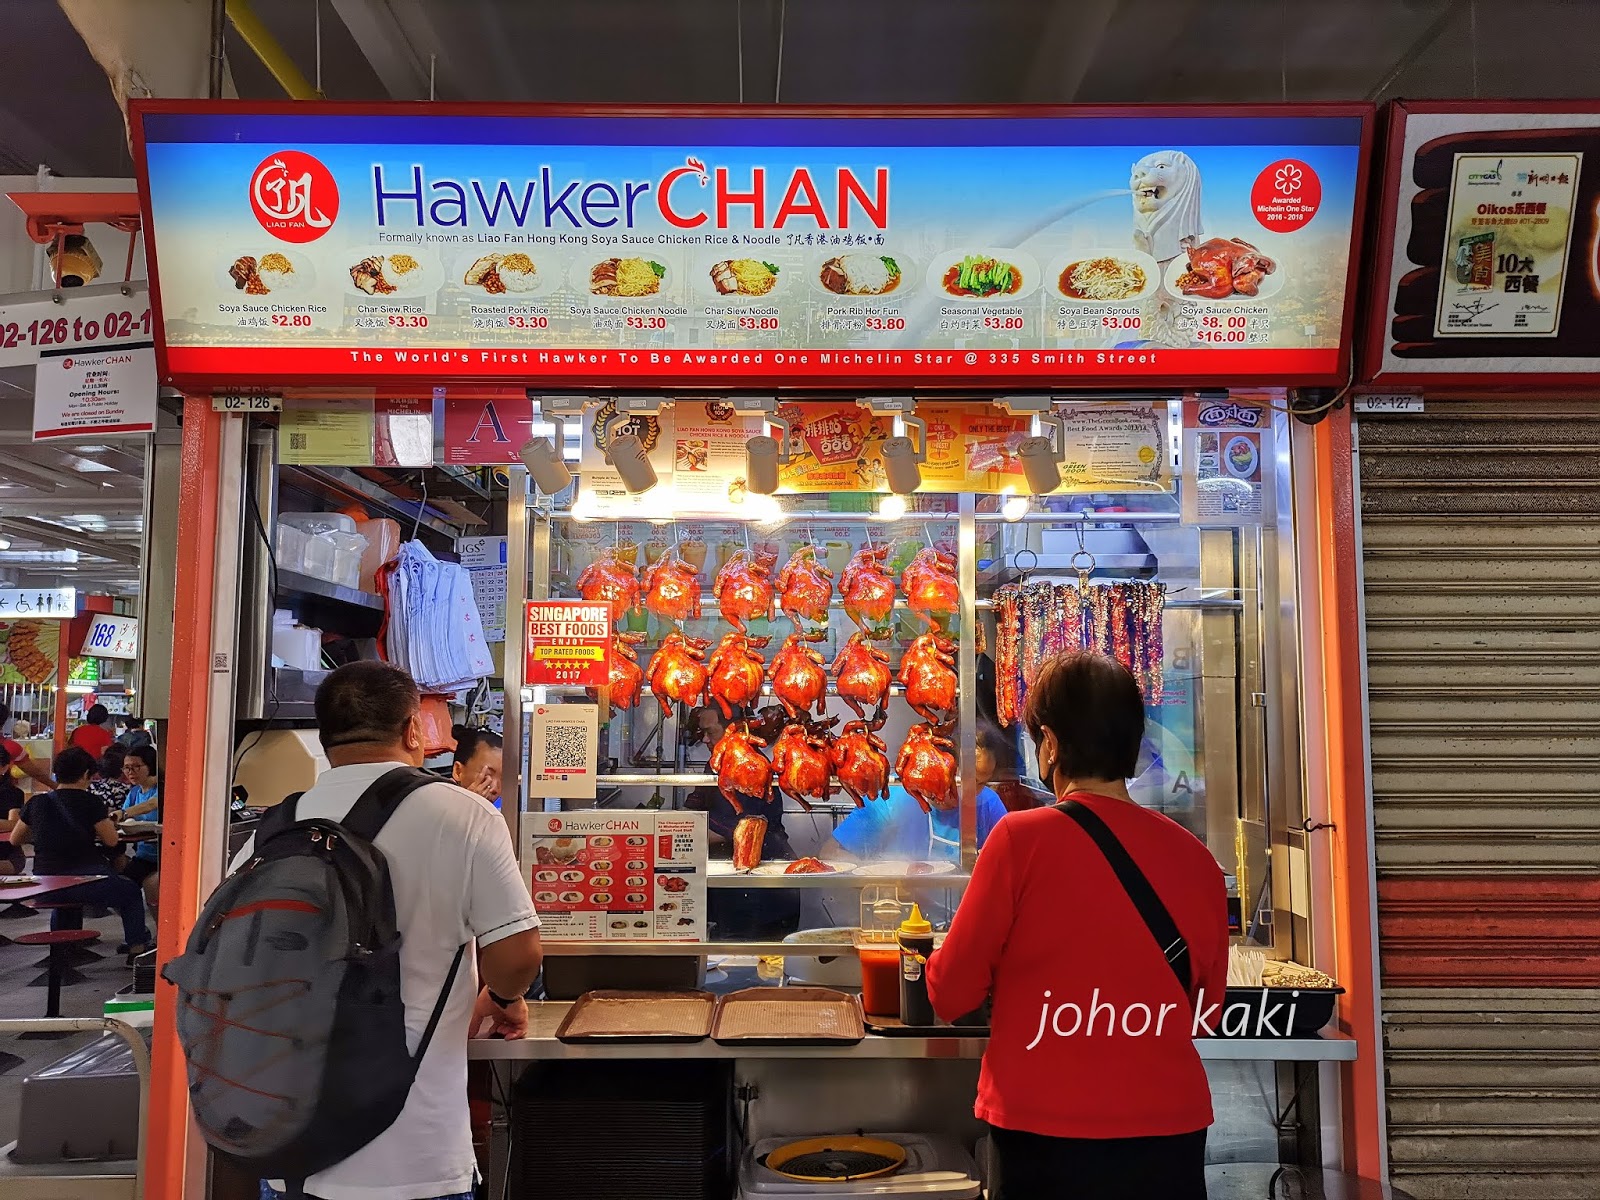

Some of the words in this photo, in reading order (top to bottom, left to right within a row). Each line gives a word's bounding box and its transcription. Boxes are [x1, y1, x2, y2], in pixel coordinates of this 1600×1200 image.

[1257, 205, 1285, 213] Michelin
[1286, 205, 1300, 213] One
[1301, 205, 1315, 213] Star
[266, 221, 287, 229] LIAO
[288, 221, 306, 229] FAN
[378, 232, 423, 245] Formally
[426, 232, 459, 243] known
[461, 235, 475, 243] as
[477, 233, 501, 243] Liao
[504, 234, 524, 243] Fan
[527, 233, 556, 246] Hong
[559, 234, 588, 246] Kong
[591, 234, 619, 246] Soya
[621, 234, 655, 244] Sauce
[657, 234, 701, 244] Chicken
[704, 234, 728, 244] Rice
[731, 234, 740, 244] &
[743, 234, 781, 244] Noodle
[218, 304, 241, 314] Soya
[242, 305, 269, 313] Sauce
[271, 305, 306, 313] Chicken
[308, 305, 327, 313] Rice
[357, 305, 379, 313] Char
[380, 305, 401, 313] Siew
[471, 306, 506, 314] Roasted
[508, 306, 529, 314] Pork
[530, 306, 549, 314] Rice
[570, 307, 591, 316] Soya
[593, 307, 620, 315] Sauce
[621, 307, 656, 315] Chicken
[658, 307, 688, 315] Noodle
[704, 307, 726, 315] Char
[727, 307, 748, 315] Siew
[749, 307, 779, 315] Noodle
[827, 307, 847, 315] Pork
[849, 307, 864, 315] Rib
[865, 307, 881, 315] Hor
[883, 307, 899, 315] Fun
[941, 307, 980, 315] Seasonal
[981, 307, 1023, 316] Vegetable
[1059, 307, 1082, 316] Soya
[1083, 307, 1105, 315] Bean
[1107, 307, 1140, 316] Sprouts
[1182, 306, 1204, 315] Soya
[1205, 306, 1232, 314] Sauce
[1233, 306, 1269, 314] Chicken
[271, 314, 312, 327] $2.80
[388, 315, 428, 328] $3.30
[508, 316, 548, 328] $3.30
[627, 317, 666, 329] $3.30
[739, 317, 779, 330] $3.80
[866, 317, 906, 330] $3.80
[984, 317, 1024, 330] $3.80
[1102, 317, 1141, 329] $3.00
[73, 316, 100, 342] to
[1197, 330, 1246, 343] $16.00
[350, 351, 384, 362] The
[394, 351, 469, 363] World's
[481, 352, 528, 363] First
[539, 352, 608, 364] Hawker
[619, 352, 639, 364] To
[650, 352, 672, 364] Be
[683, 353, 763, 364] Awarded
[774, 353, 808, 364] One
[820, 353, 903, 364] Michelin
[914, 353, 953, 364] Star
[964, 353, 979, 365] @
[989, 353, 1020, 364] 335
[1031, 353, 1085, 364] Smith
[1096, 353, 1157, 364] Street
[225, 396, 270, 409] 02-126
[1366, 397, 1412, 409] 02-127
[465, 400, 512, 443] A
[968, 425, 985, 433] ONLY
[985, 425, 995, 433] THE
[529, 606, 608, 622] SINGAPORE
[90, 623, 116, 648] 168
[531, 623, 561, 635] BEST
[565, 623, 604, 636] FOODS
[540, 648, 552, 656] TOP
[553, 648, 574, 656] RATED
[574, 648, 595, 656] FOODS
[556, 671, 580, 679] 2017
